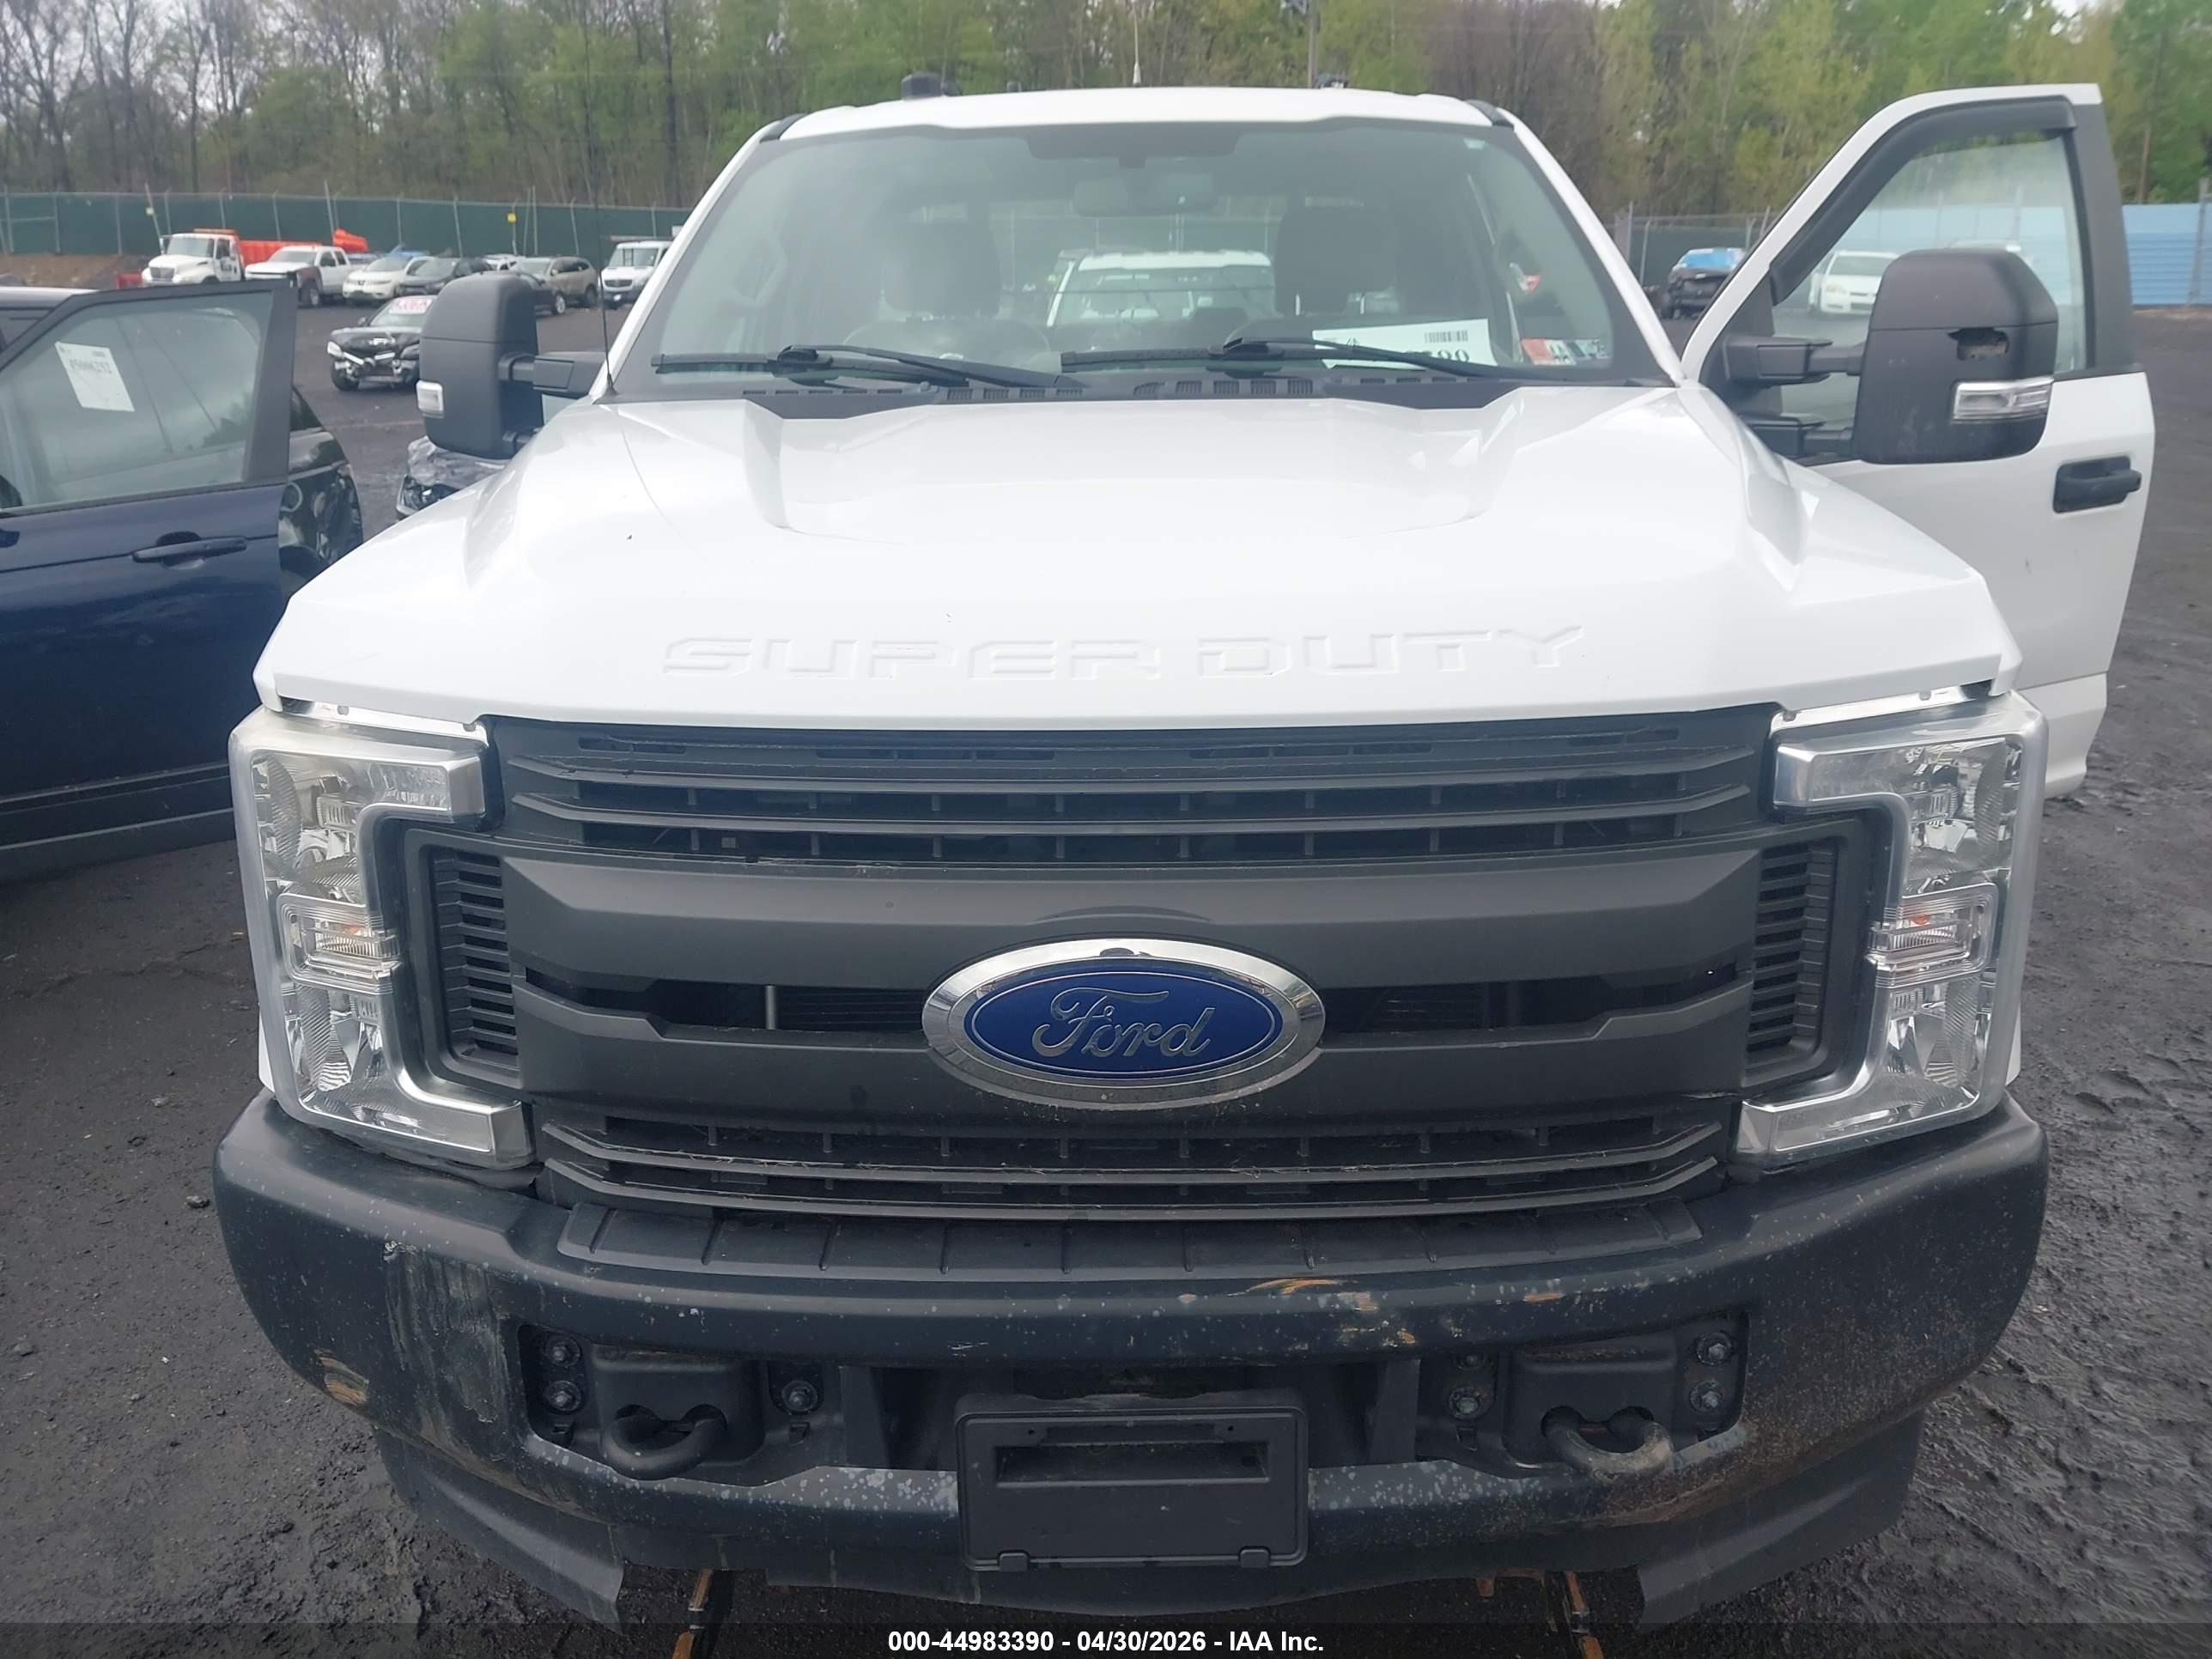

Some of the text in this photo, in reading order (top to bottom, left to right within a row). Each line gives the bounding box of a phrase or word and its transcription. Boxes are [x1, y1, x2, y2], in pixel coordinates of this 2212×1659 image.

[663, 625, 1584, 680] SUPER DUTY
[1031, 987, 1216, 1058] Ford
